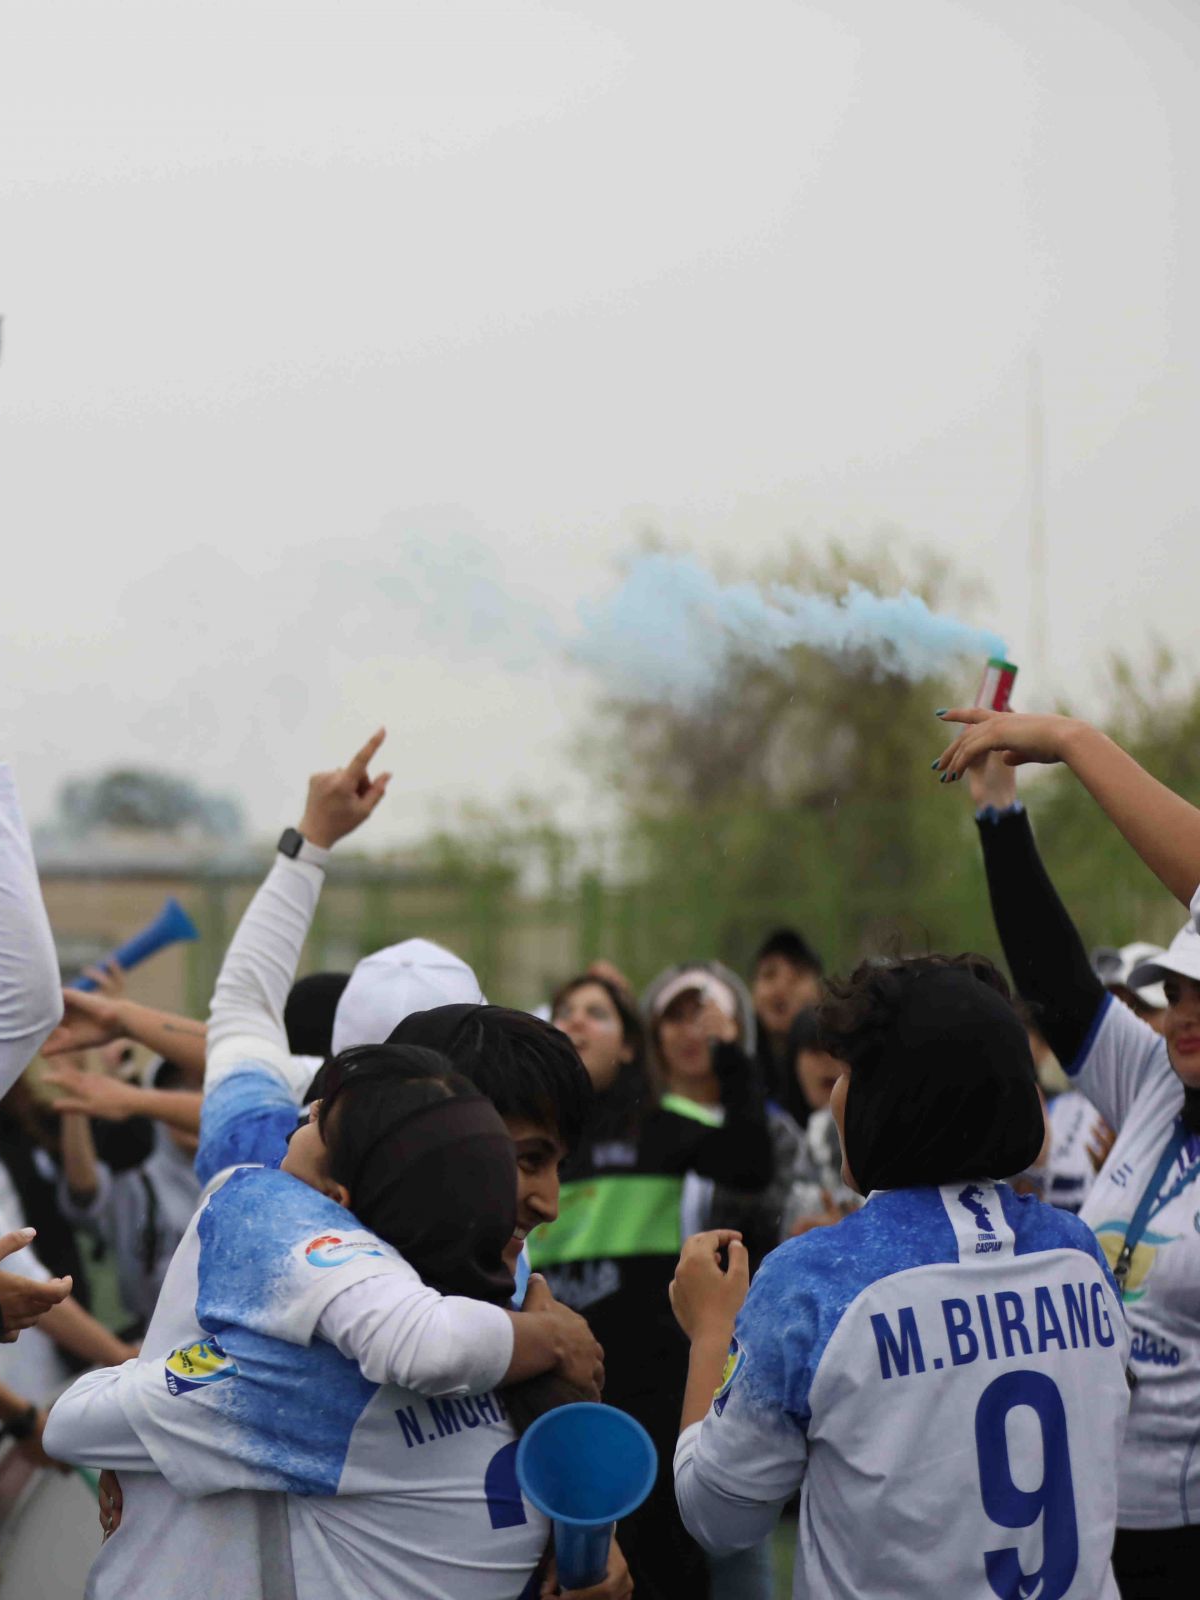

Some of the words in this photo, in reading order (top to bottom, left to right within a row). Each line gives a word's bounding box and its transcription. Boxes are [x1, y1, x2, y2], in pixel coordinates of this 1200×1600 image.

[975, 1240, 1003, 1254] CASPIAN
[869, 1281, 1116, 1380] M.BIRANG
[166, 1375, 179, 1395] FIFA
[394, 1390, 507, 1449] N.MOH
[974, 1369, 1080, 1600] 9
